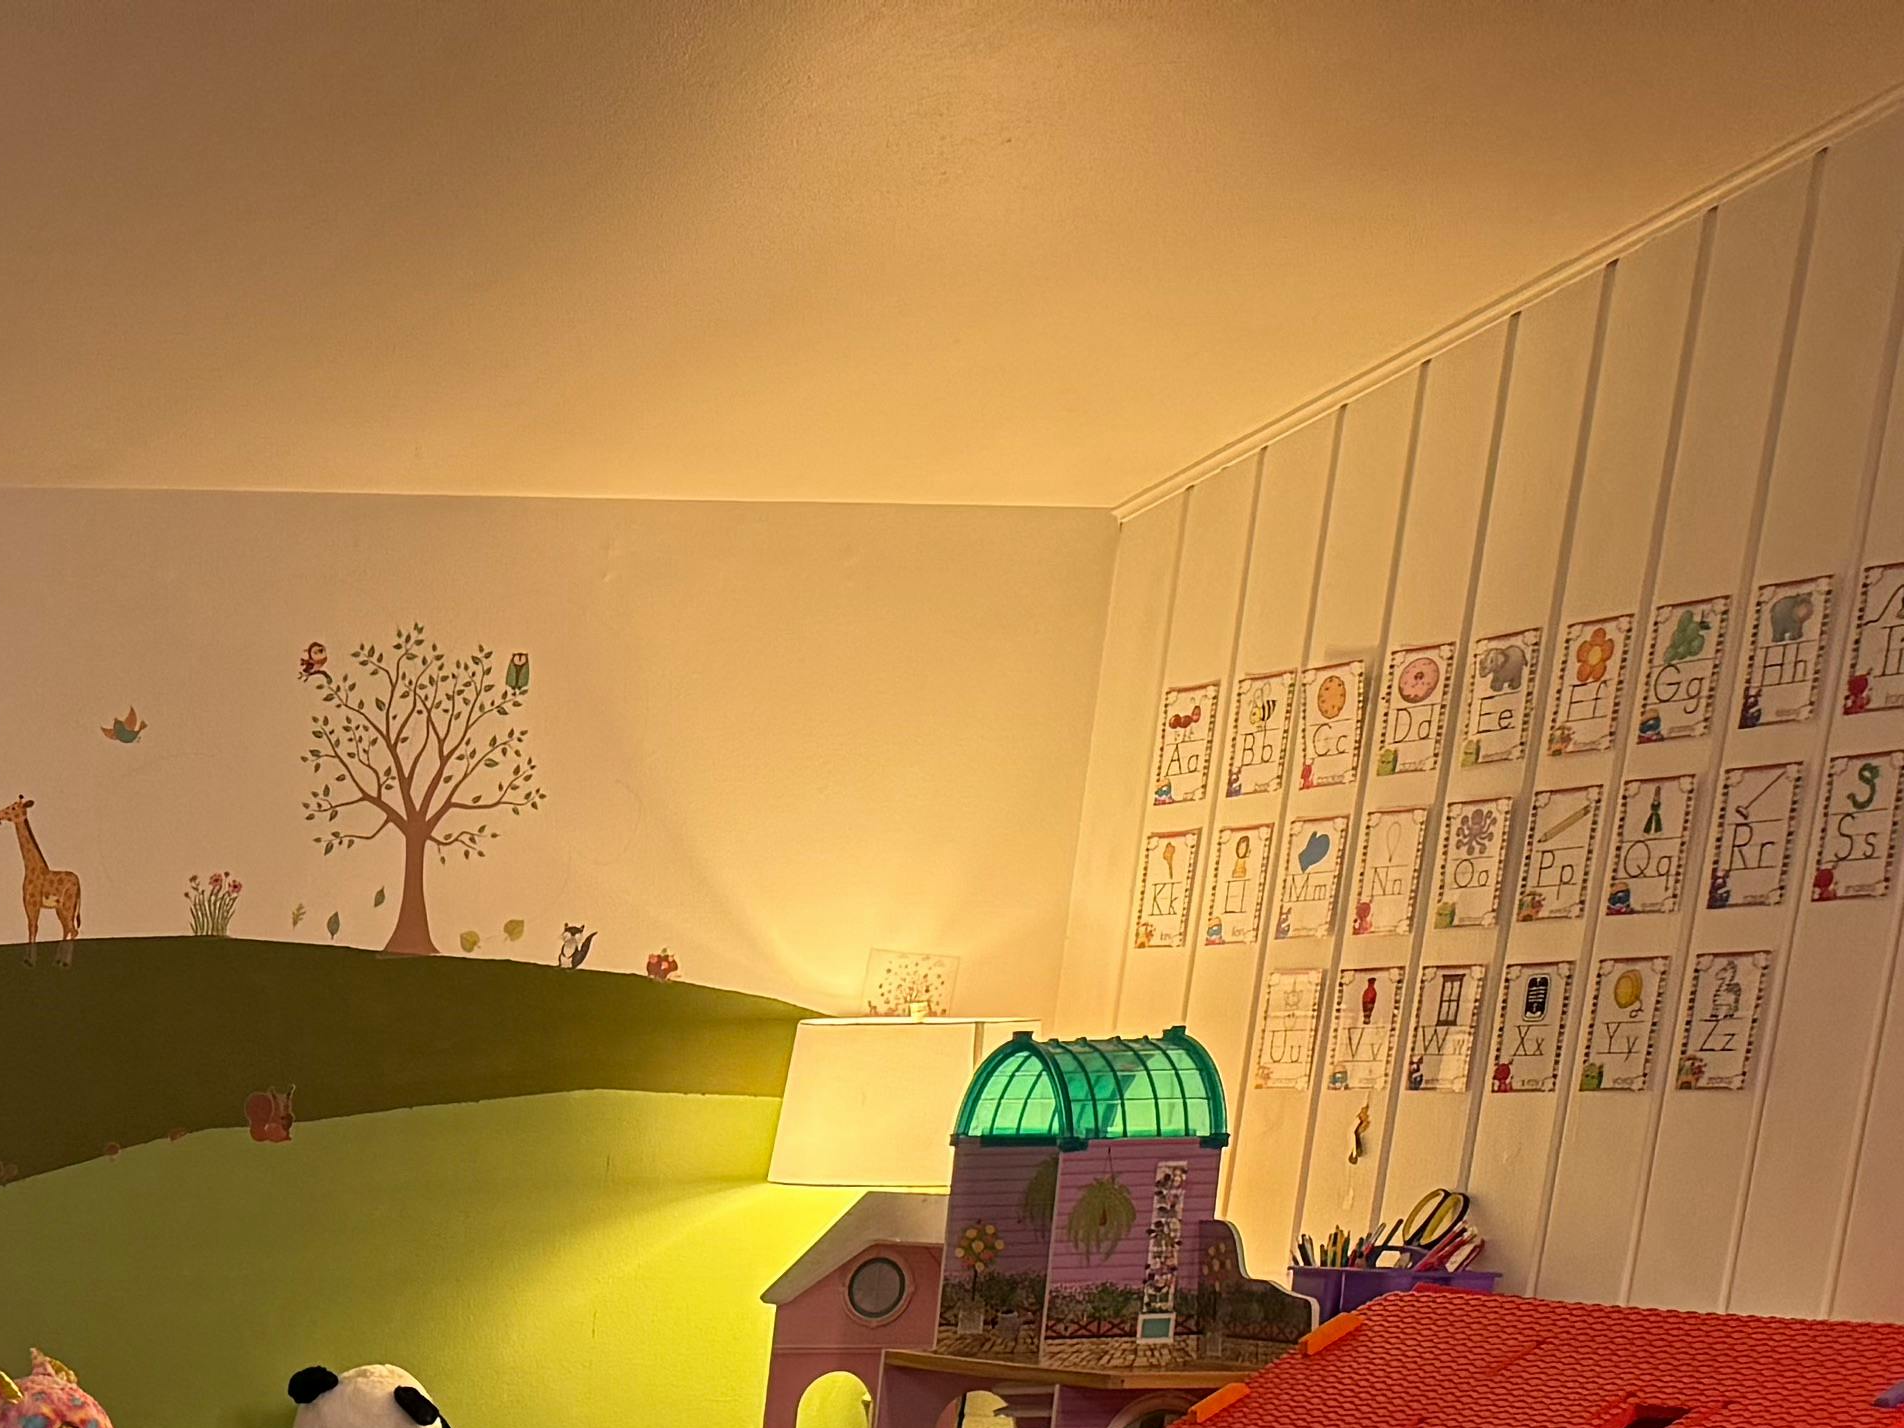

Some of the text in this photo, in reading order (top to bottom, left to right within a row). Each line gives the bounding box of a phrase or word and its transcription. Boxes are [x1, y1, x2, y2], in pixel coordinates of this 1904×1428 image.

[1761, 644, 1808, 687] Hh
[1653, 664, 1705, 714] Gg
[1393, 704, 1433, 744] Dd
[1476, 697, 1514, 734] Ee
[1241, 728, 1273, 765] Bb
[1312, 723, 1347, 756] Cc
[1165, 743, 1200, 776] Aa
[1728, 822, 1776, 870] Rr
[1833, 812, 1877, 862] Ss
[1371, 866, 1402, 897] Nn
[1452, 858, 1490, 888] Oo
[1536, 849, 1575, 900] Pp
[1622, 839, 1674, 893] Qq
[1149, 881, 1178, 915] Kk
[1289, 873, 1328, 900] Mm
[1269, 1029, 1302, 1063] Uu
[1347, 1026, 1383, 1062] Vv
[1421, 1025, 1466, 1054] Ww
[1512, 1024, 1545, 1056] Xx
[1604, 1021, 1639, 1063] Yy
[1698, 1018, 1737, 1052] Zz
